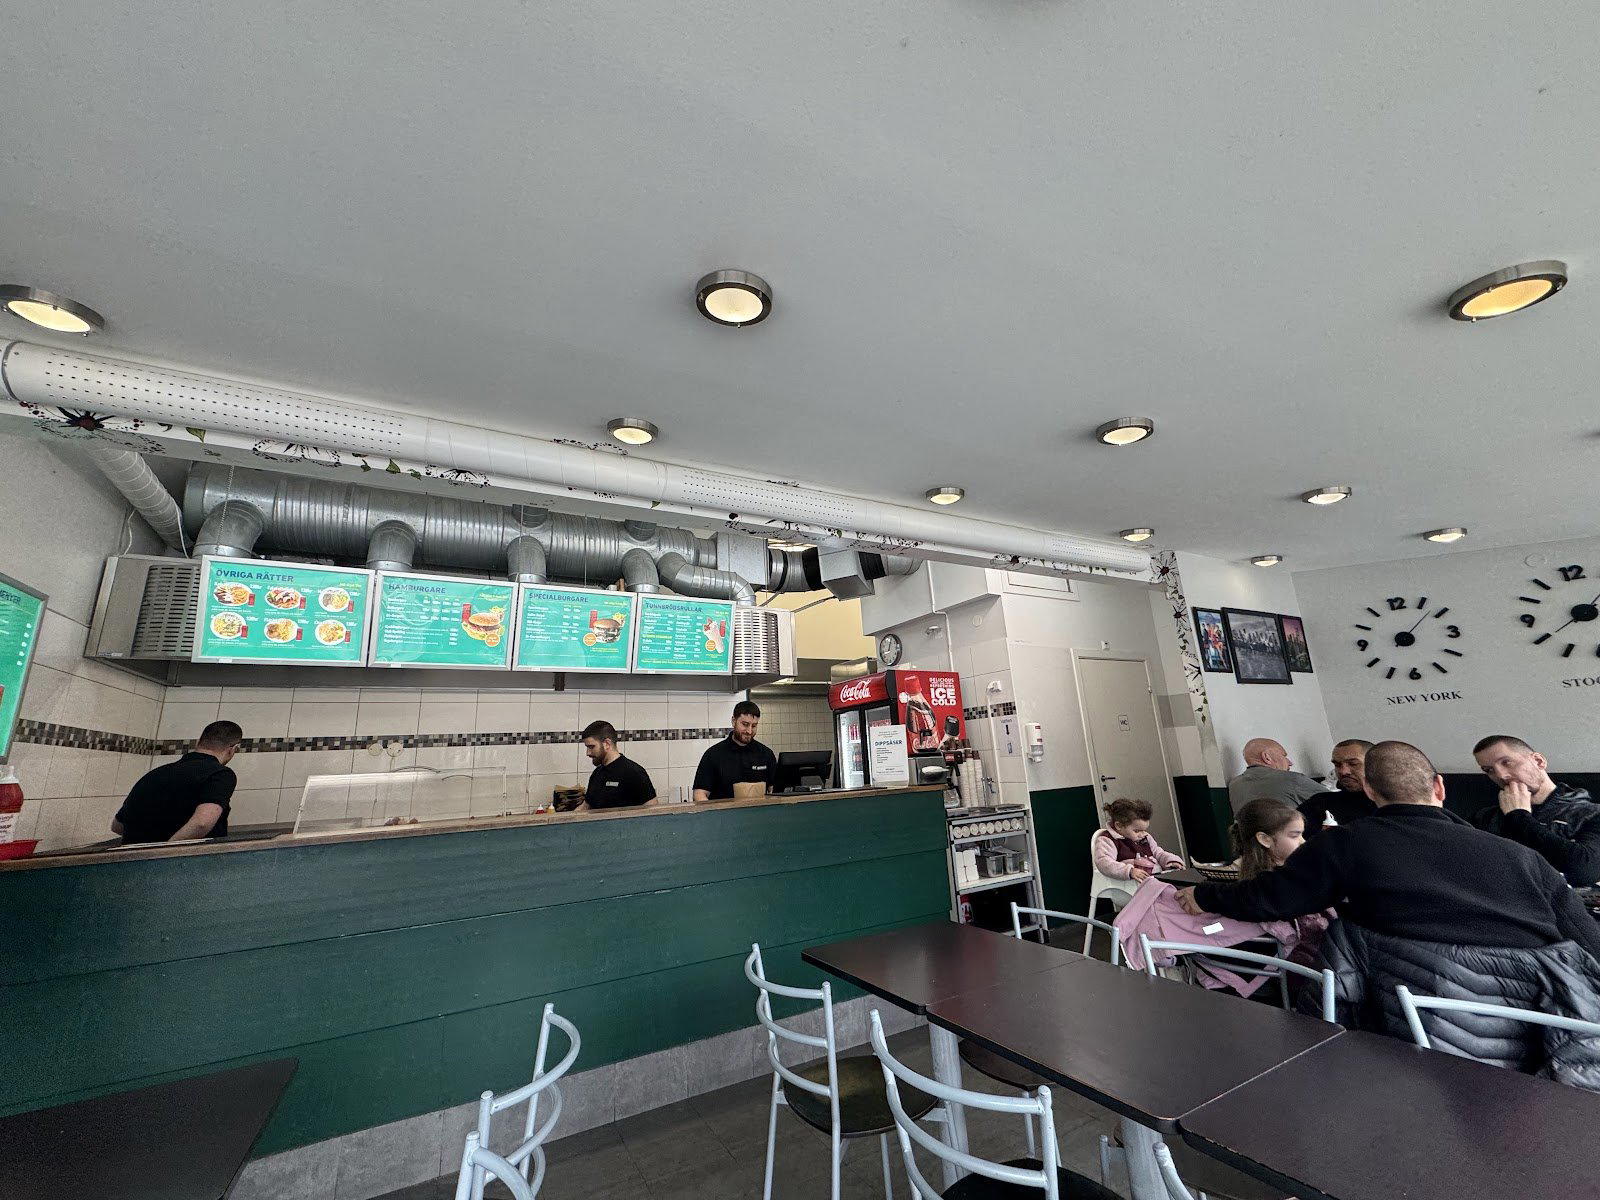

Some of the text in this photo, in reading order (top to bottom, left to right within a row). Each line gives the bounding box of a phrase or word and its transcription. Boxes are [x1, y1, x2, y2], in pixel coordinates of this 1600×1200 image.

[216, 569, 294, 582] ÖVRIGA RÄTTER
[1557, 565, 1586, 582] 12
[388, 583, 446, 594] HAMBURGARE
[529, 592, 589, 603] SPECIALBURGARE
[1387, 597, 1406, 611] 12
[1519, 614, 1536, 628] 9
[1447, 625, 1461, 639] 3
[1356, 639, 1369, 652] 9
[1408, 667, 1422, 681] 6
[840, 678, 872, 703] Coca-Cola
[930, 688, 956, 699] ICE
[931, 698, 957, 706] COLD
[1386, 690, 1463, 706] NEW YORK
